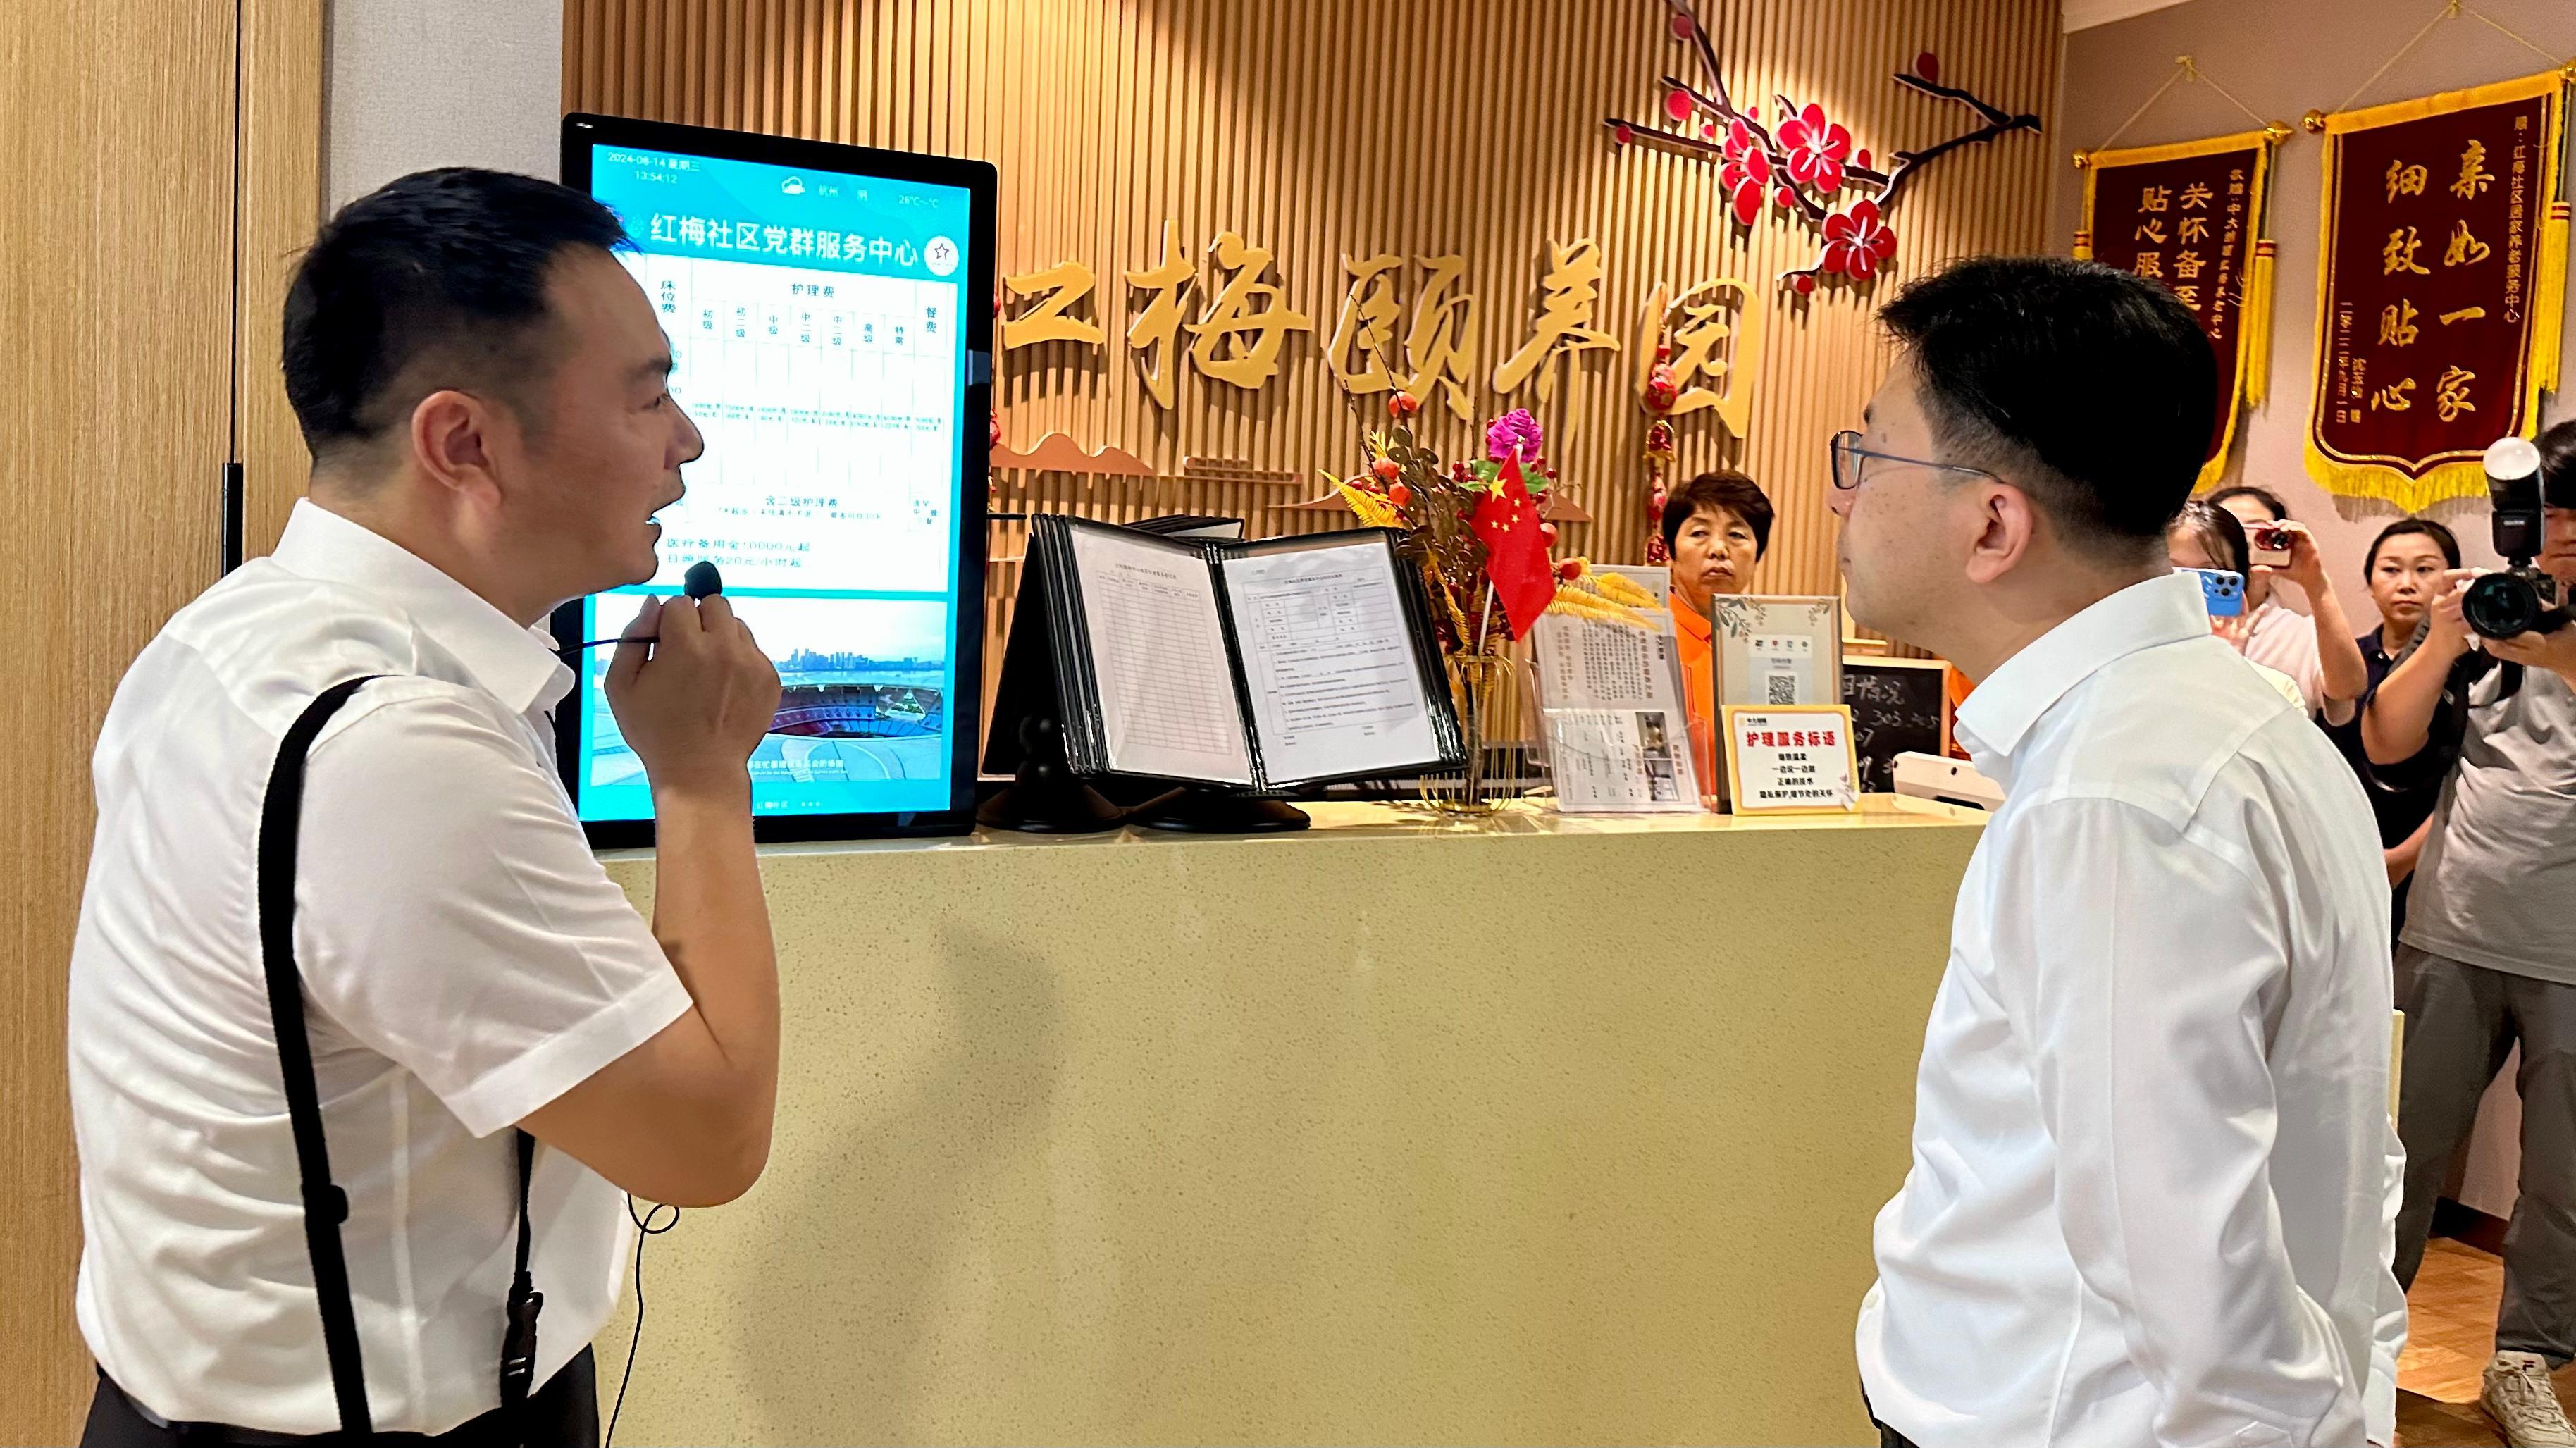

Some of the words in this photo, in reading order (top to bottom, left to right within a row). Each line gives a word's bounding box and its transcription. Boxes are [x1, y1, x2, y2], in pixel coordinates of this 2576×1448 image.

[650, 212, 919, 268] 红梅社区党群服务中心
[2173, 182, 2214, 311] 关怀备至
[791, 283, 835, 298] 护理费
[2370, 159, 2431, 411] 细致贴心
[1746, 731, 1836, 748] 护理服务标语
